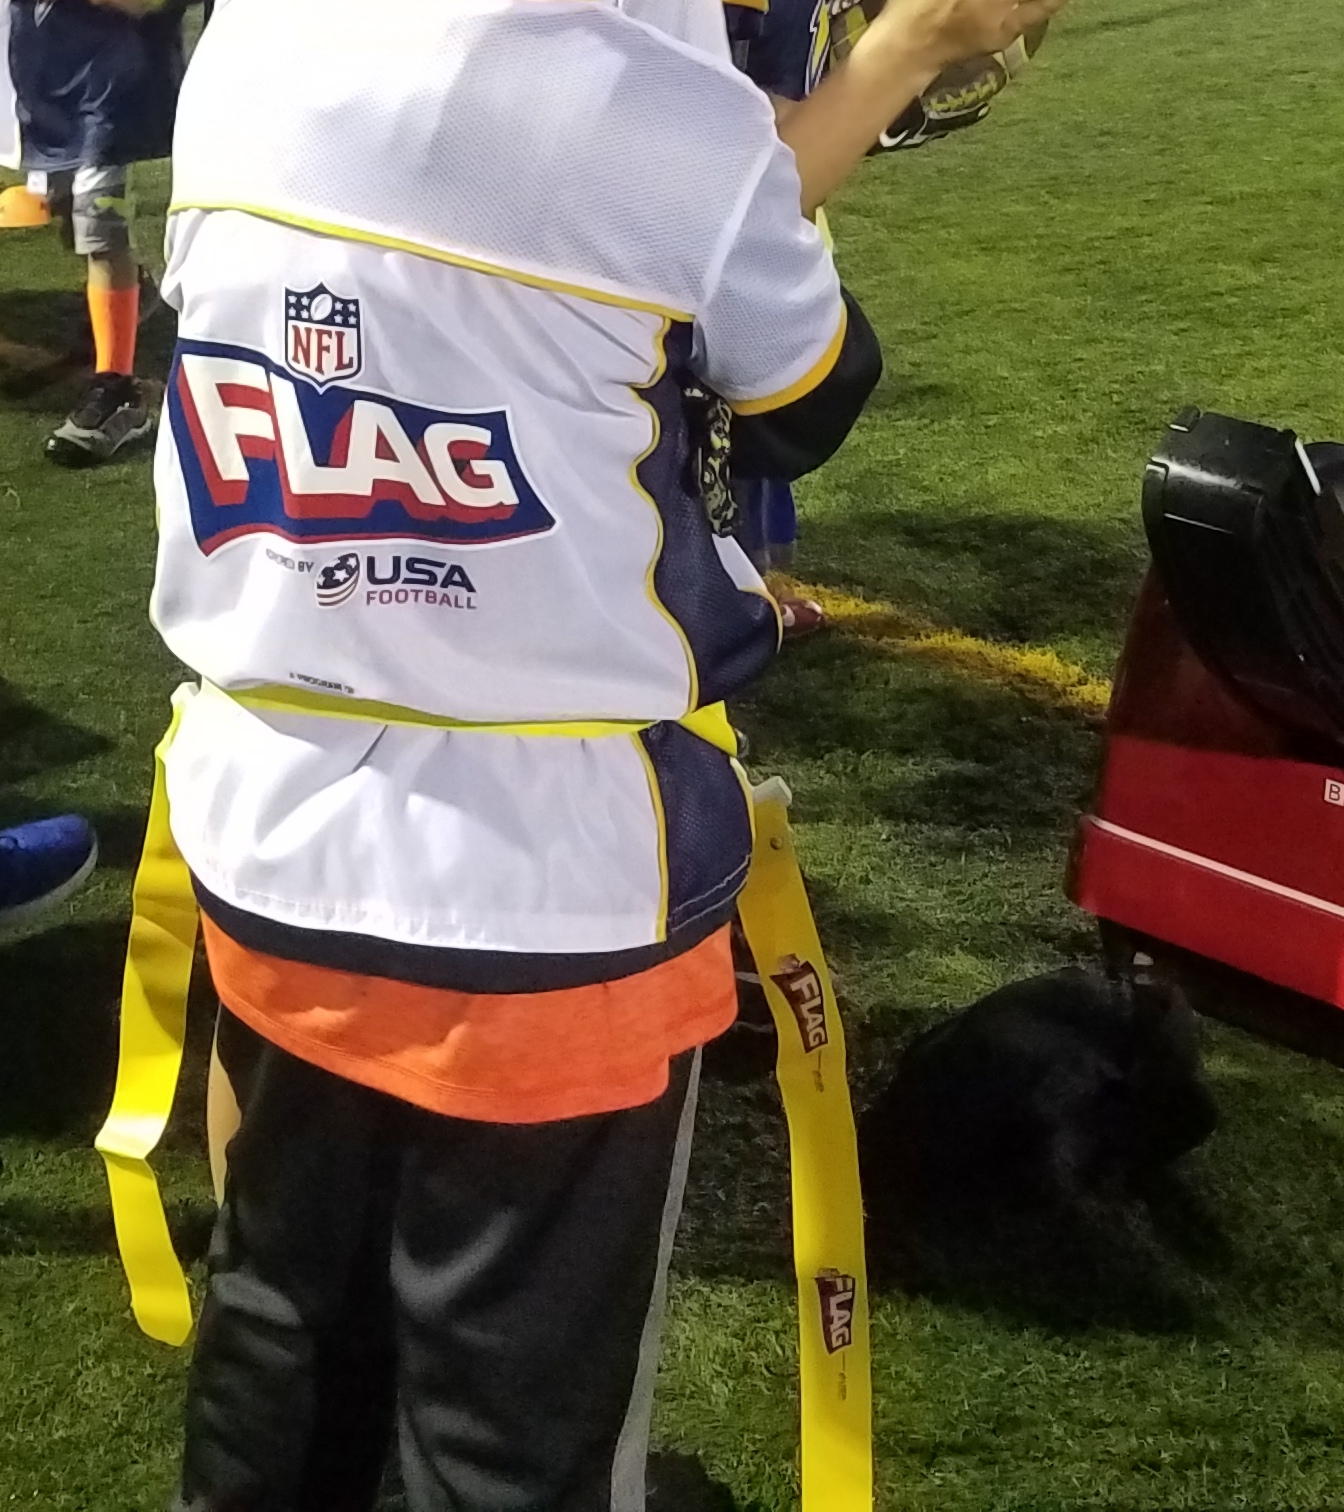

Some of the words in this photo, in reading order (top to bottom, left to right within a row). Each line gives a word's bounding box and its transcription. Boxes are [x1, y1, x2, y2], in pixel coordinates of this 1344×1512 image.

[292, 325, 354, 376] NFL
[180, 353, 520, 508] FLAG
[366, 555, 477, 593] USA
[366, 588, 477, 610] FOOTBALL
[1328, 783, 1341, 802] B
[789, 972, 827, 1049] FLAG
